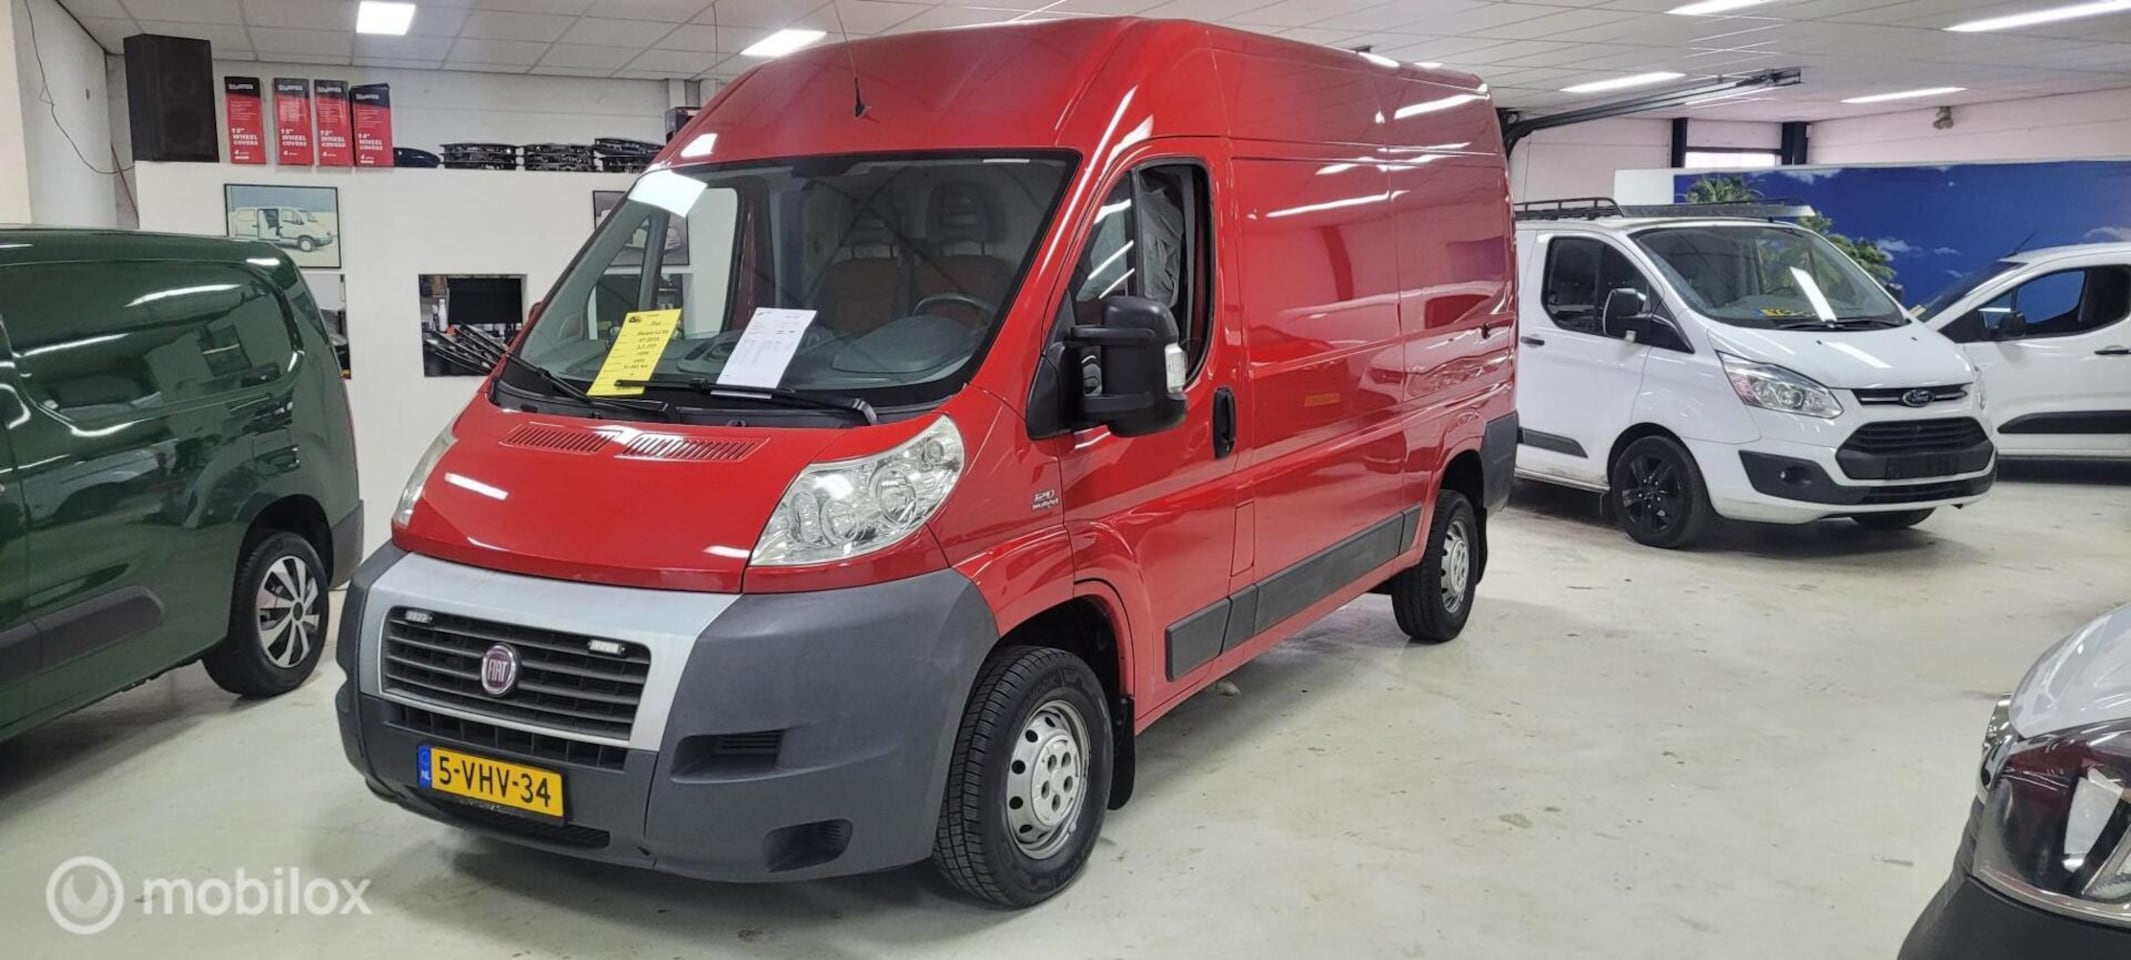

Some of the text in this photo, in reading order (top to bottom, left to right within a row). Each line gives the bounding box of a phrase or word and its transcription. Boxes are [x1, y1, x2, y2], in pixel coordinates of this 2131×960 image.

[487, 658, 509, 682] FIAT
[420, 770, 432, 781] NL
[438, 755, 552, 808] 5-VHV-34
